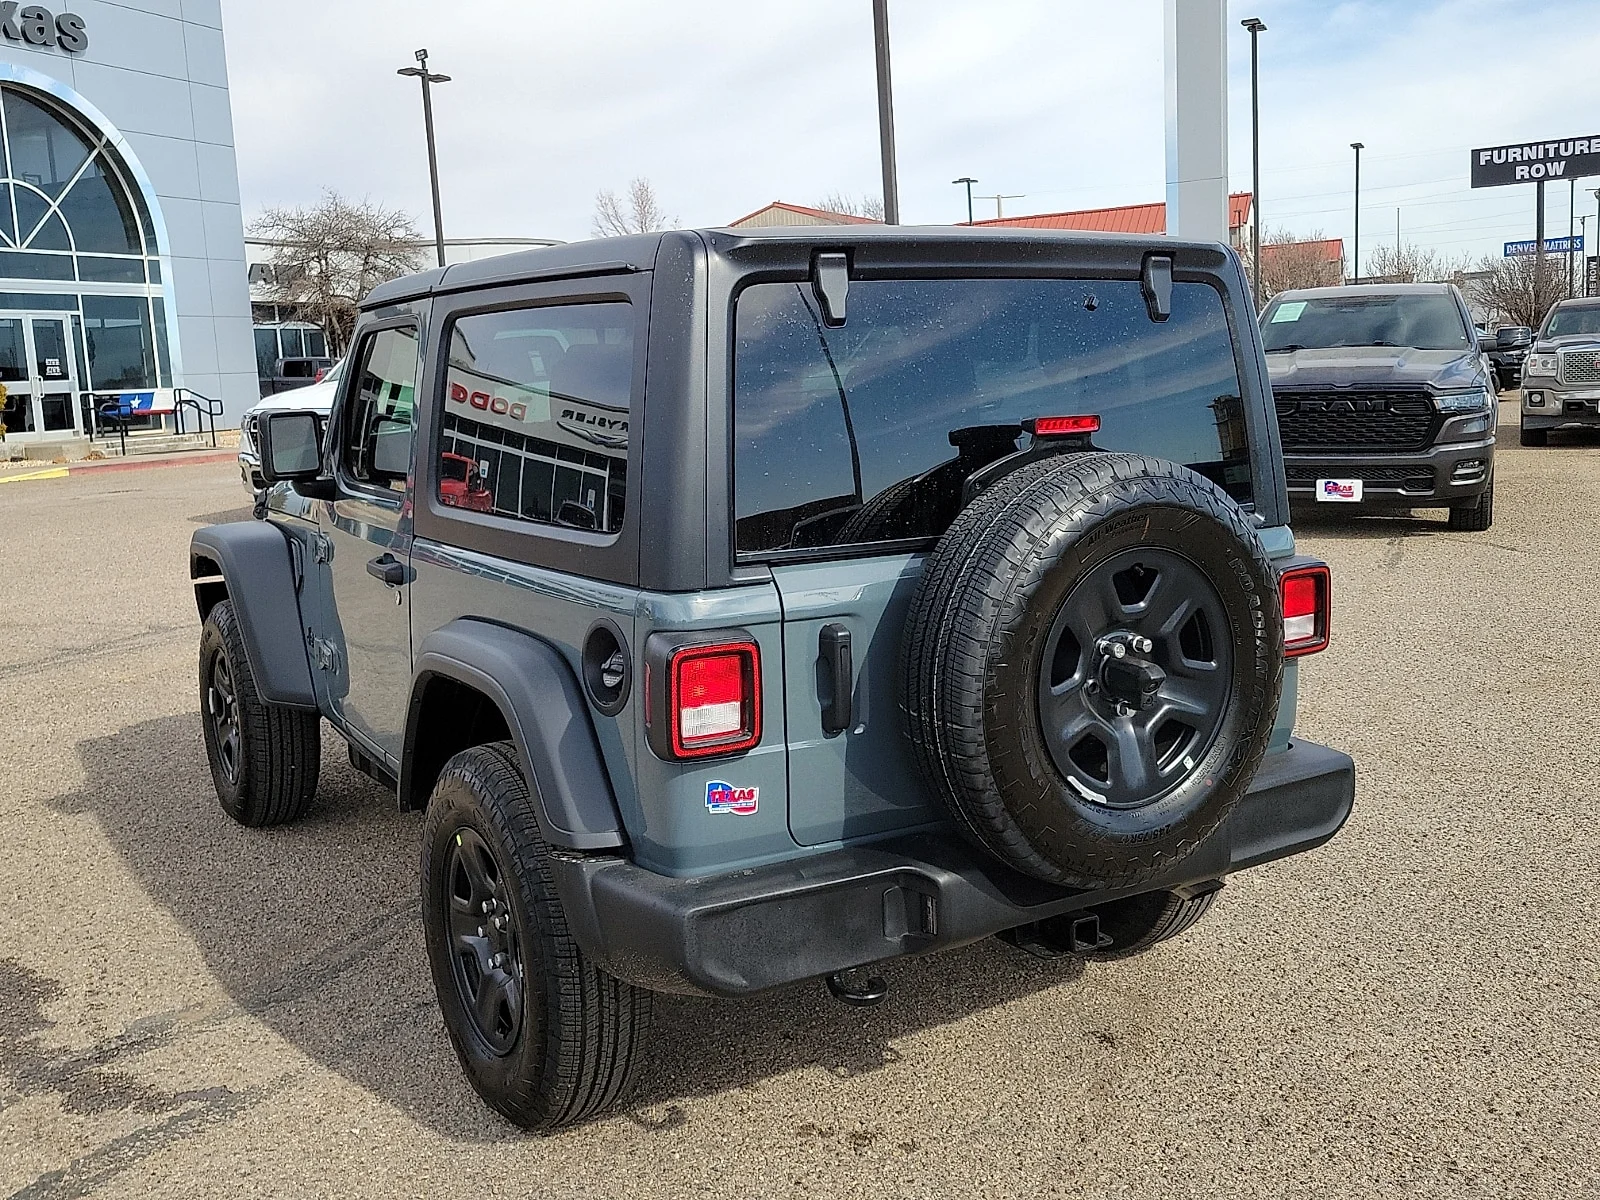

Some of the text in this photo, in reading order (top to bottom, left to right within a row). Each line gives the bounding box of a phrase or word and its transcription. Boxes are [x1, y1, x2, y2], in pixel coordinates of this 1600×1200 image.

[1480, 139, 1600, 165] FURNITURE
[1515, 161, 1566, 180] ROW
[1506, 239, 1581, 254] DENVE MATTRSS
[1300, 400, 1385, 411] RAM
[711, 789, 755, 802] TEXAS
